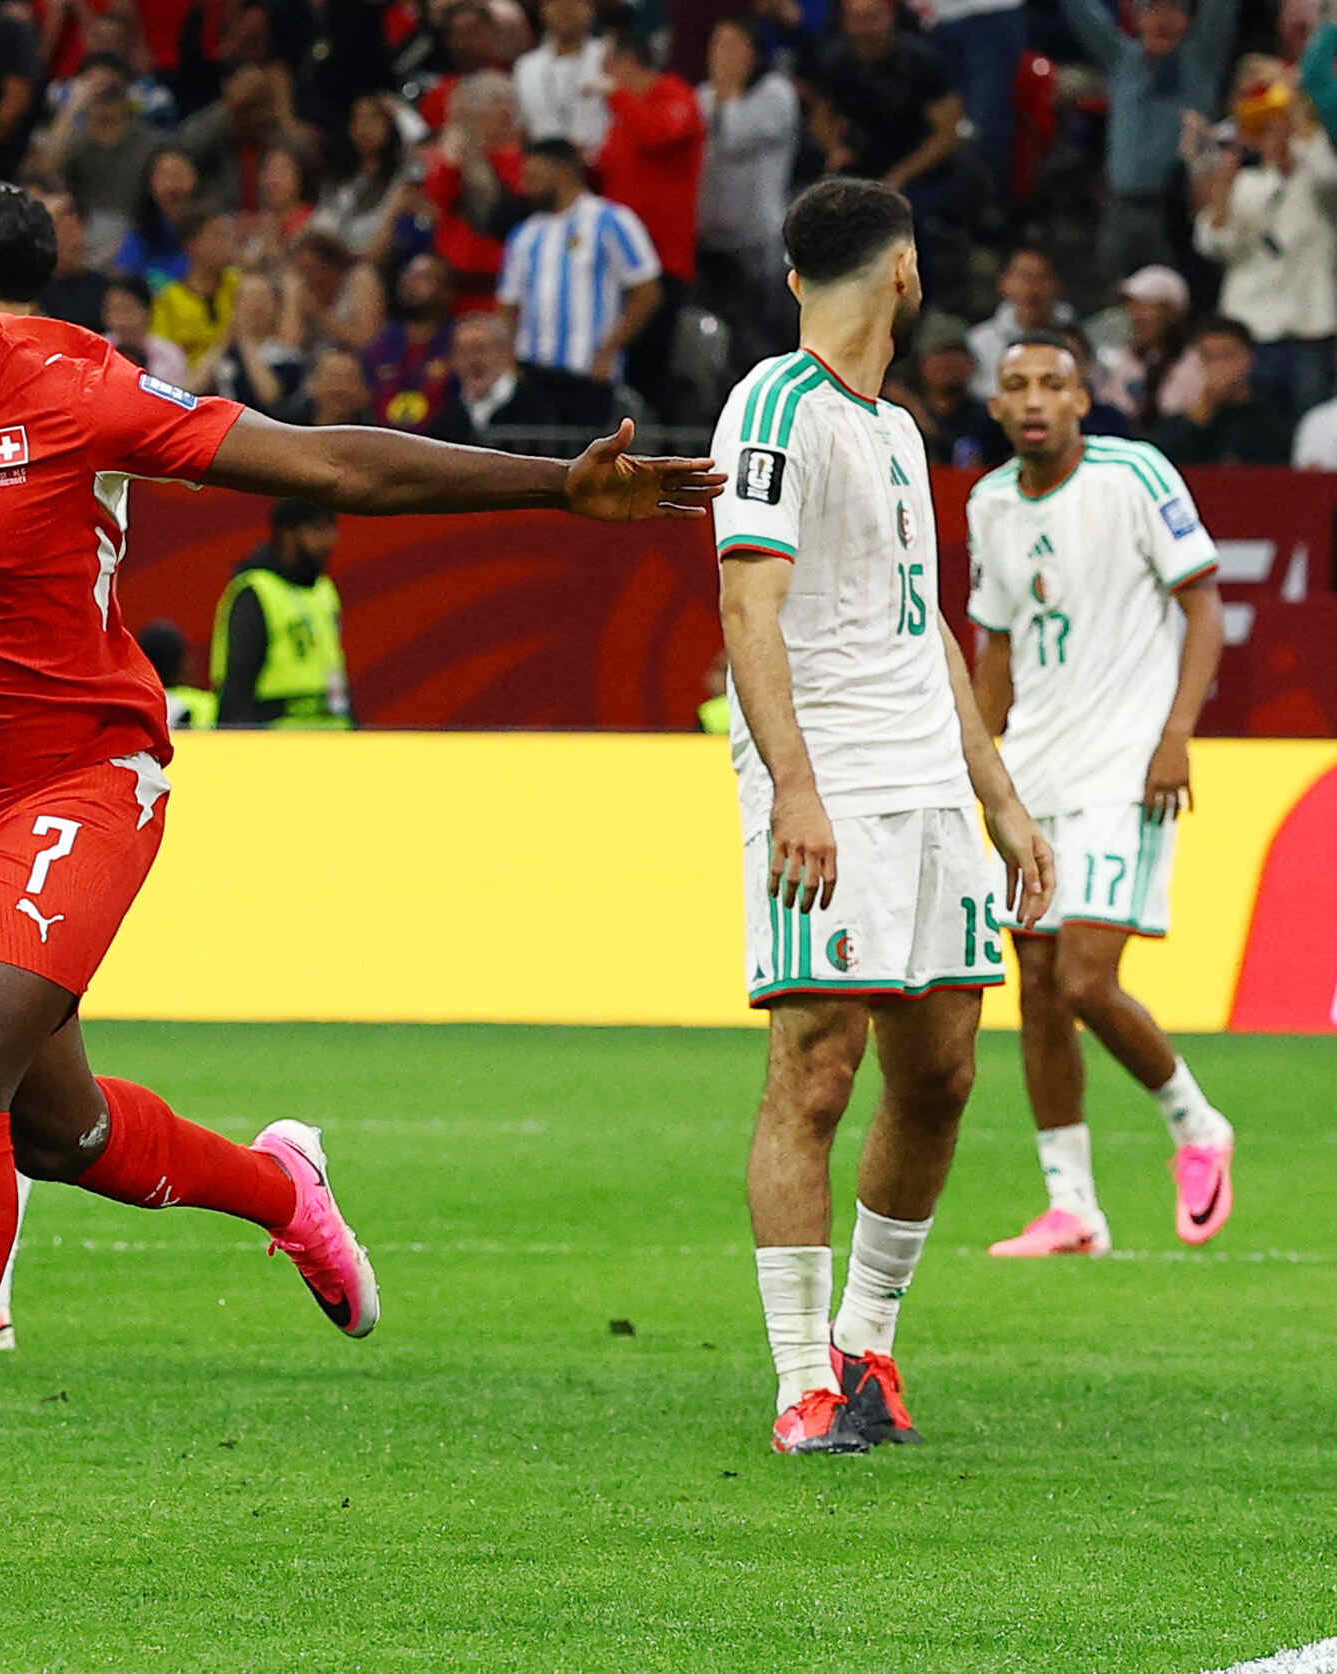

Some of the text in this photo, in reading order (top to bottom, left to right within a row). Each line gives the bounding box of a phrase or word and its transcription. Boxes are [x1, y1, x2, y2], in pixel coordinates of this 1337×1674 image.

[896, 563, 927, 636] 15
[1031, 610, 1071, 667] 17
[25, 815, 83, 895] 7
[1085, 853, 1126, 906] 17
